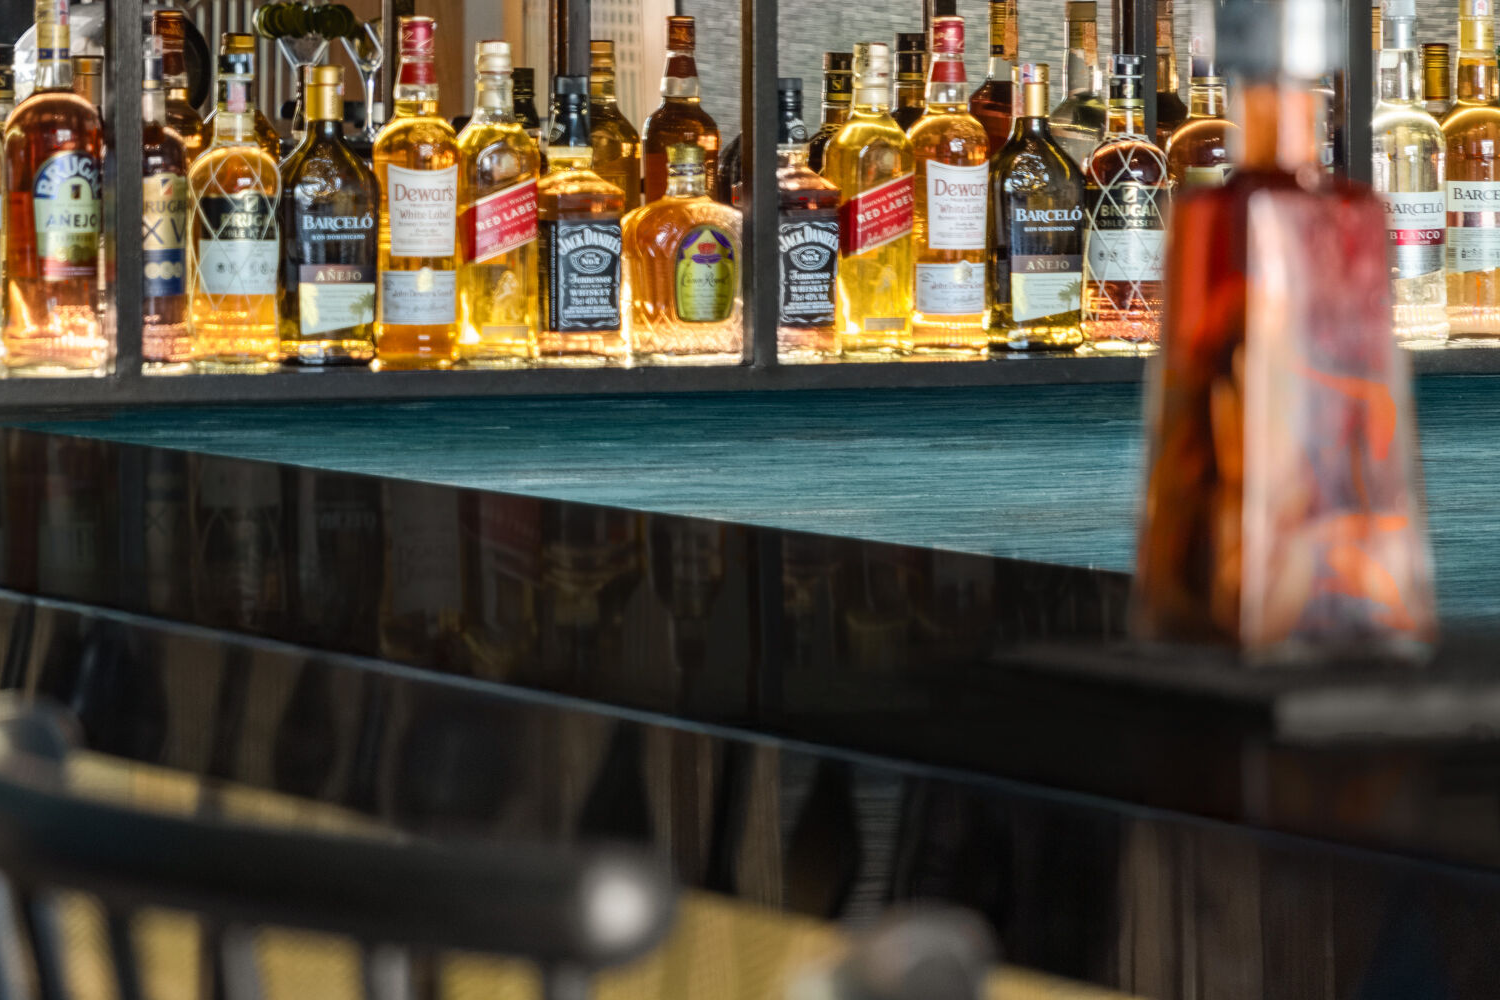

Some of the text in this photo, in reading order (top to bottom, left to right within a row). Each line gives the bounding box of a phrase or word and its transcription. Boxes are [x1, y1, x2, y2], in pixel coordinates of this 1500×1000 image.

[857, 194, 914, 223] RED LABEL
[1015, 205, 1083, 223] BARCELÓ
[1100, 204, 1157, 217] BRUGAL
[1382, 199, 1444, 215] BARCELÓ
[302, 212, 374, 231] BARCELÓ
[476, 216, 501, 231] RED
[778, 230, 805, 252] JACK
[1389, 231, 1440, 240] BLANCO
[558, 233, 584, 255] JACK
[1026, 258, 1070, 270] AÑEJO
[316, 269, 362, 281] AÑEJO
[569, 289, 611, 297] WHISKEY
